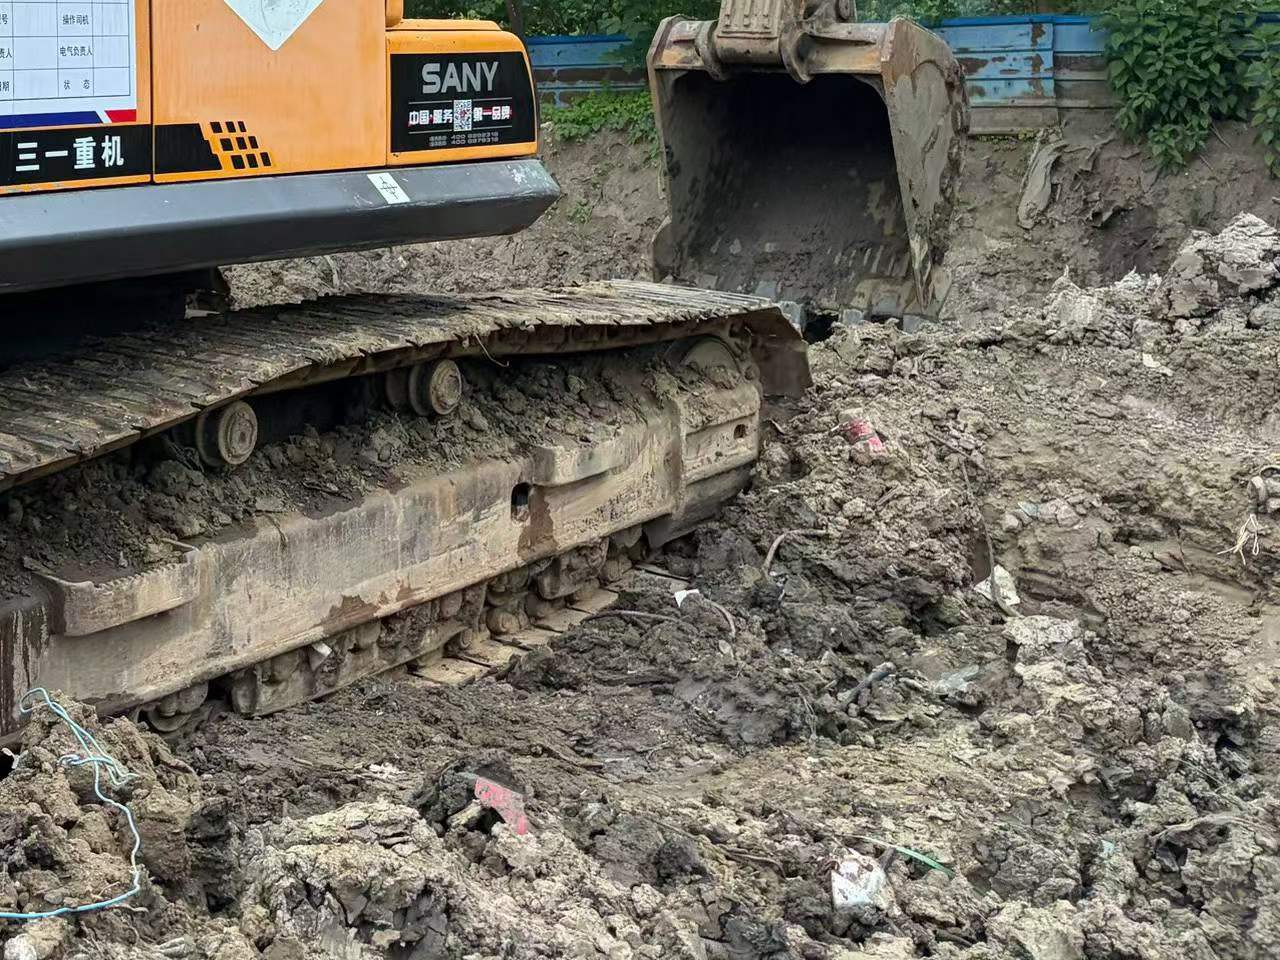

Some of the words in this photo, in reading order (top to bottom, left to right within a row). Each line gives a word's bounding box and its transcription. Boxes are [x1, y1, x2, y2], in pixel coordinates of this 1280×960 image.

[59, 46, 93, 57] 电气负责人
[421, 61, 499, 94] SANY
[15, 135, 125, 172] 三一重机
